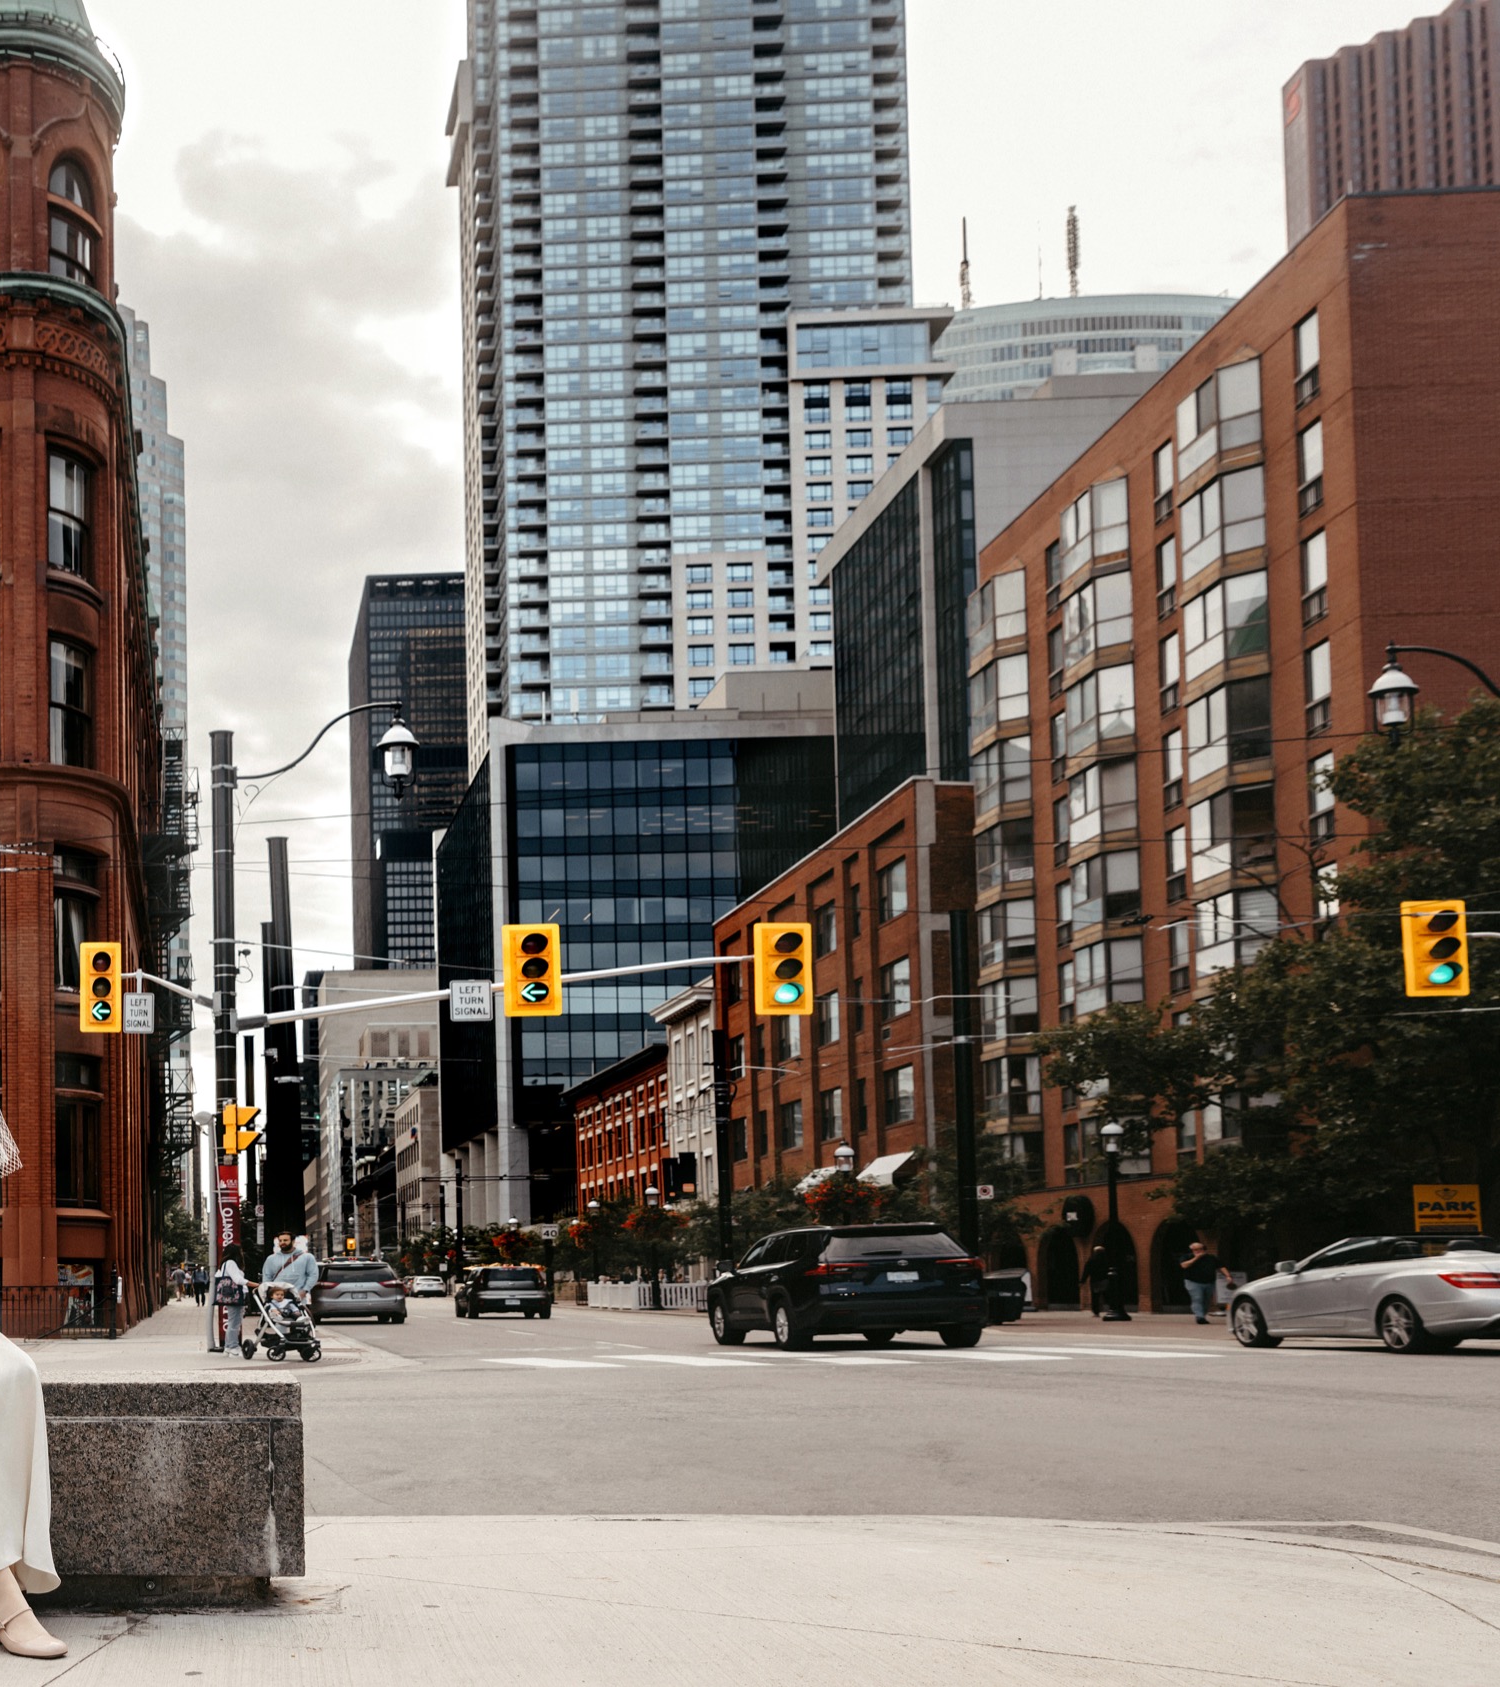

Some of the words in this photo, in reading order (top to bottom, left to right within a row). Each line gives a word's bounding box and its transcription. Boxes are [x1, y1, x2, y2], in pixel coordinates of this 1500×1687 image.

[459, 985, 482, 994] LEFT
[130, 998, 147, 1007] LEFT
[459, 996, 484, 1005] TURN
[130, 1009, 148, 1017] TURN
[455, 1007, 488, 1015] SIGNAL
[1418, 1201, 1477, 1211] PARK
[222, 1207, 234, 1251] RONTO
[543, 1229, 558, 1238] 40
